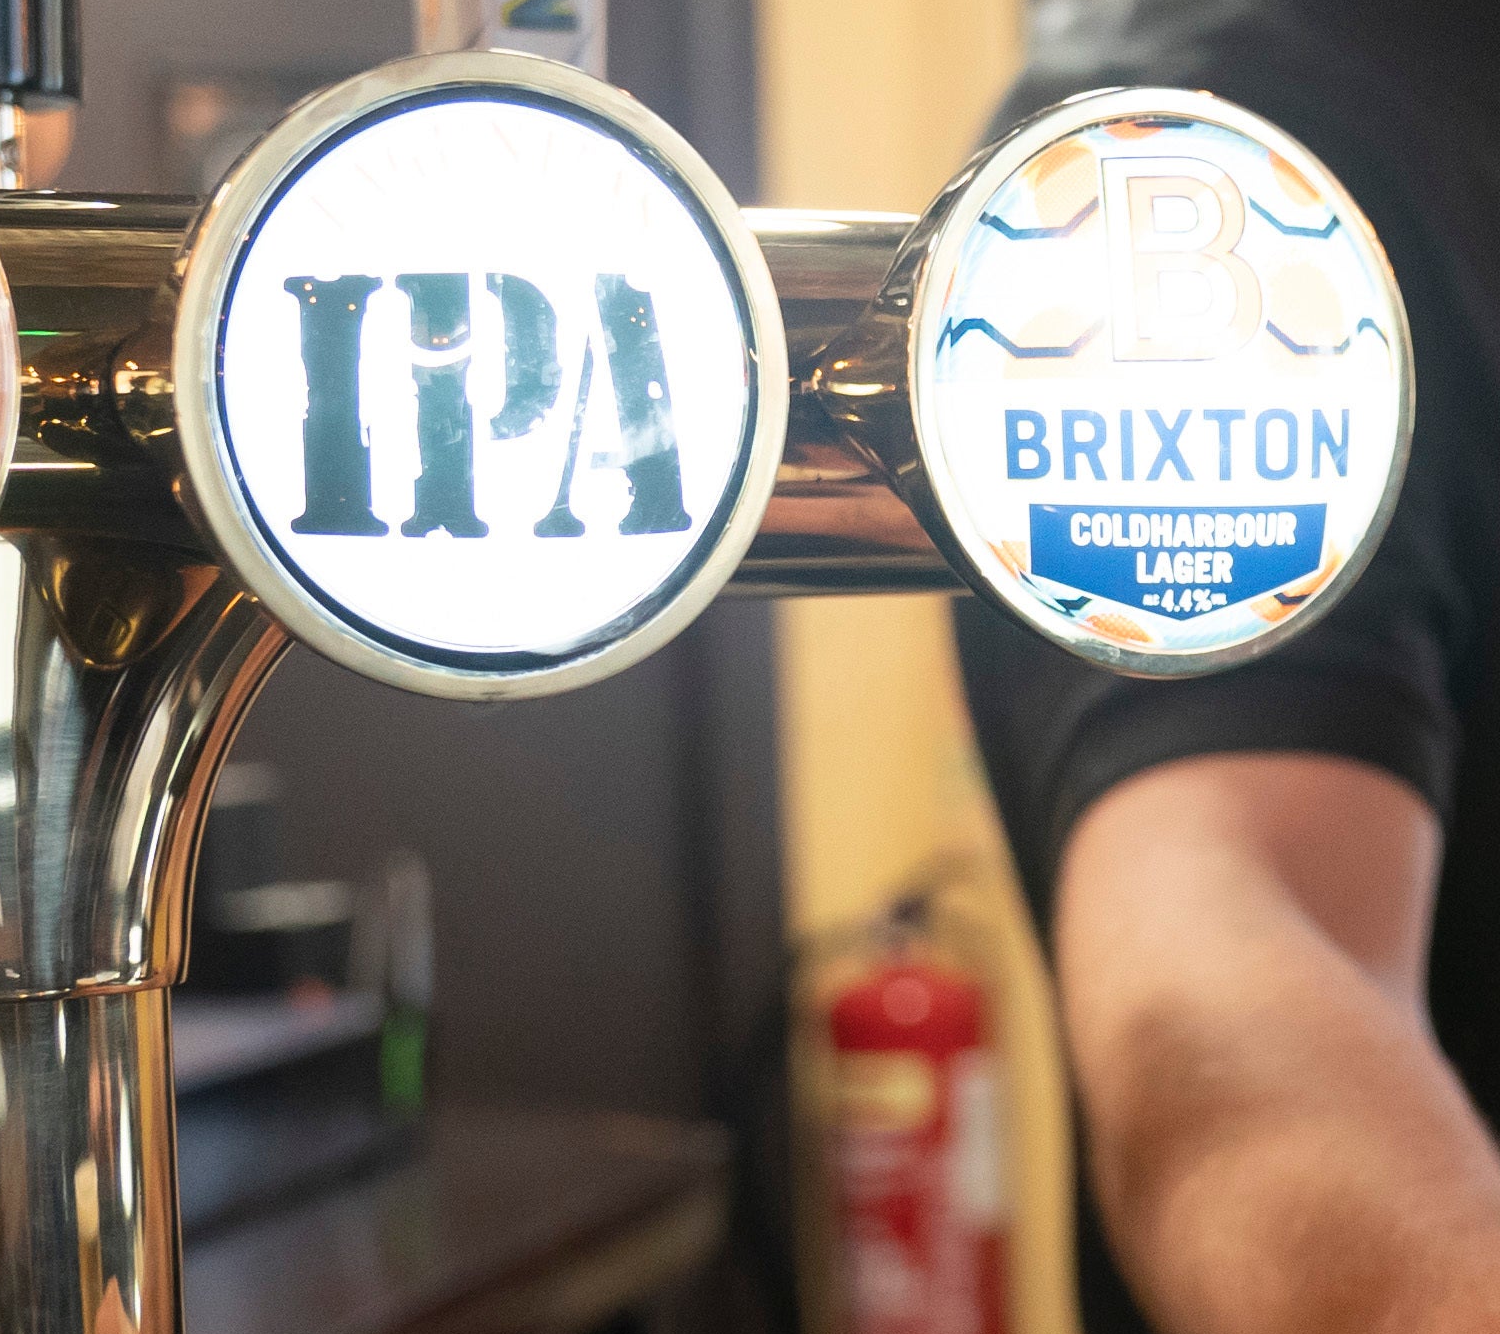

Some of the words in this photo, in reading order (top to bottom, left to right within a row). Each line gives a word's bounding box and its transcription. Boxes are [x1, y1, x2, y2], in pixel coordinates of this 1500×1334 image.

[1099, 155, 1264, 363] B
[283, 271, 693, 540] IPA
[1003, 408, 1351, 482] BRIXTON
[1069, 511, 1297, 549] COLDHARBOUR
[1135, 551, 1234, 585] LAGER
